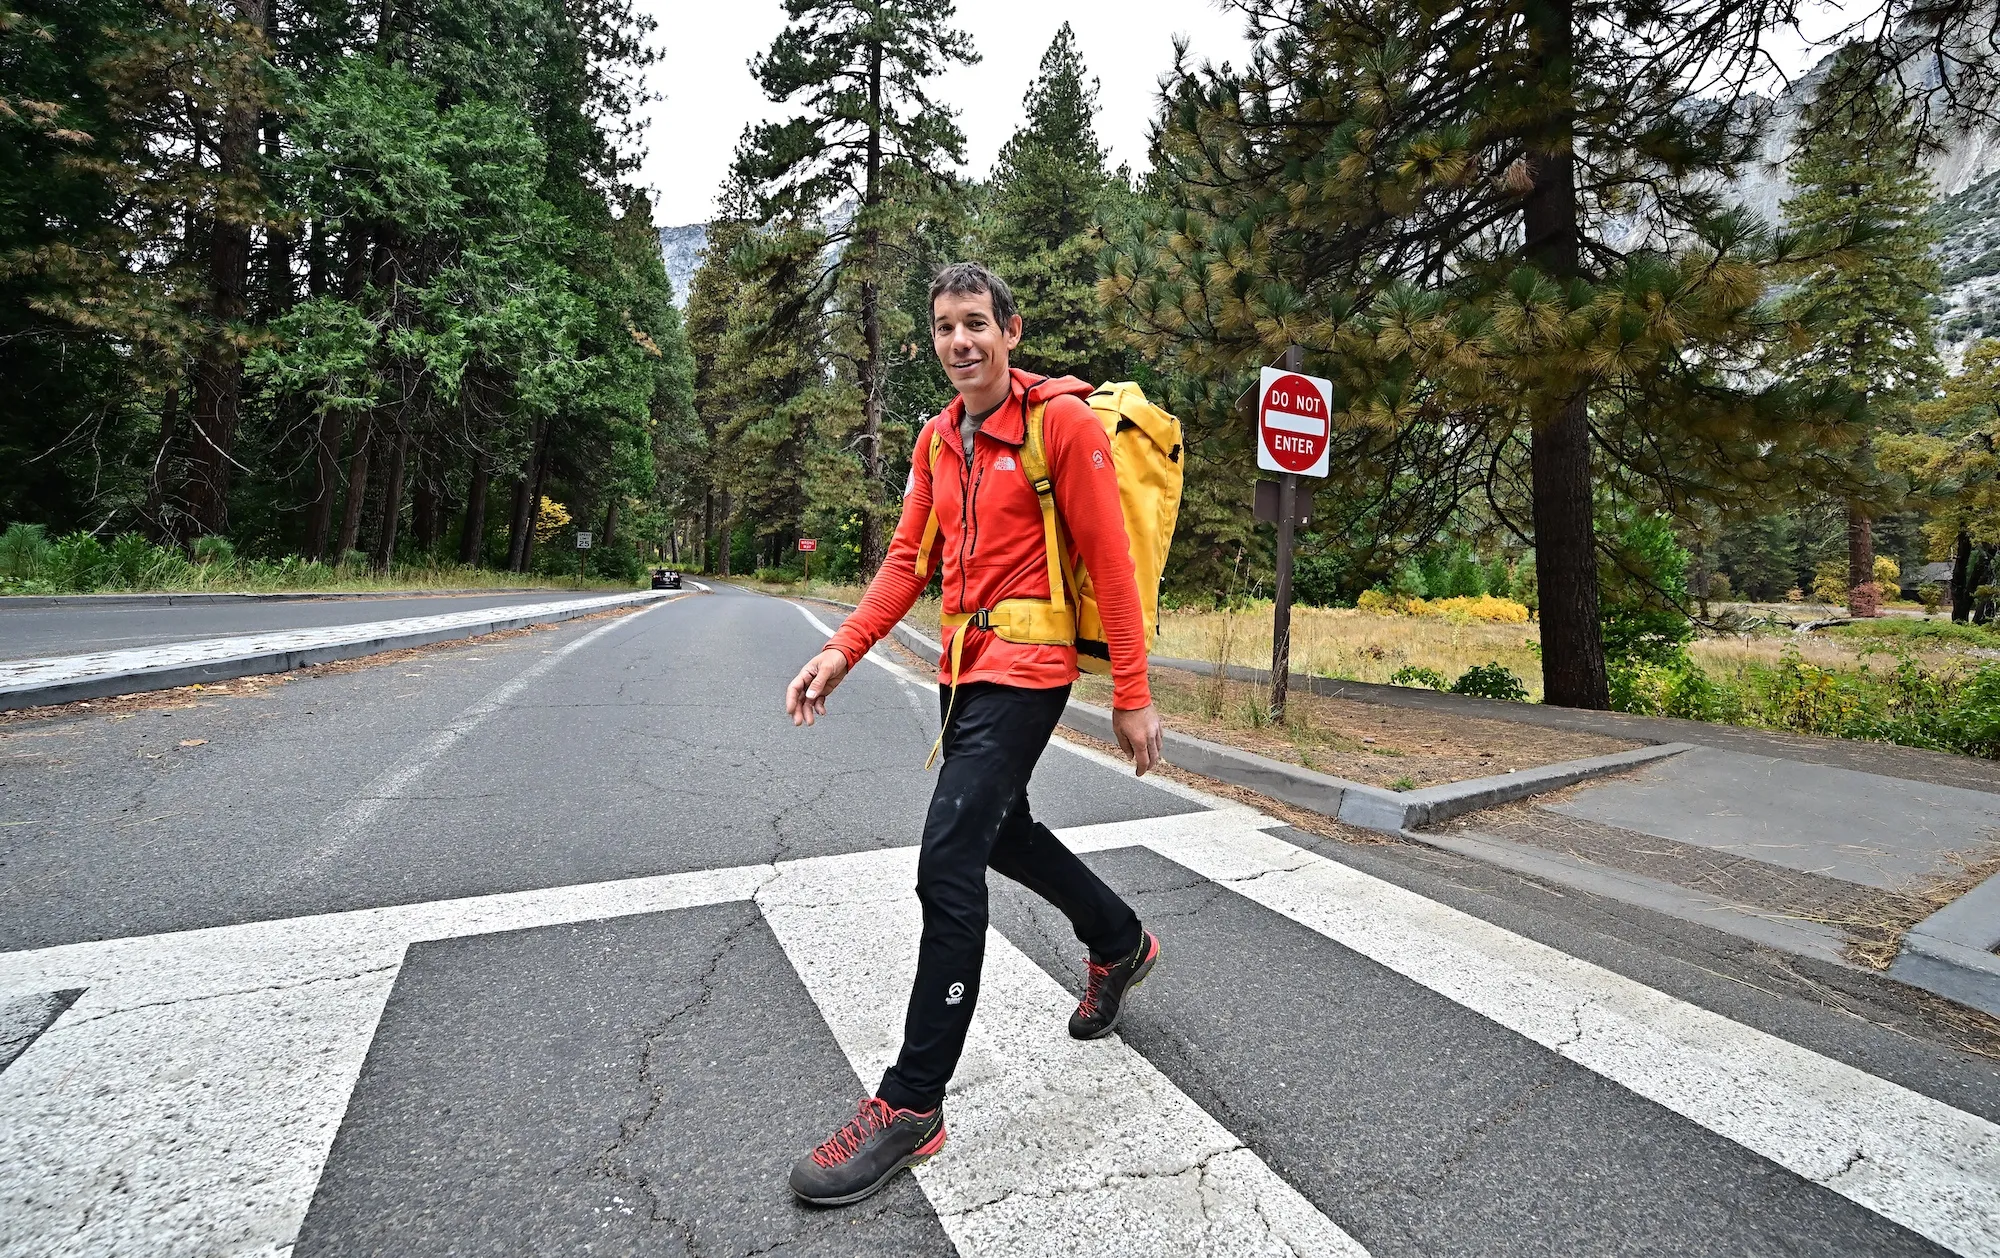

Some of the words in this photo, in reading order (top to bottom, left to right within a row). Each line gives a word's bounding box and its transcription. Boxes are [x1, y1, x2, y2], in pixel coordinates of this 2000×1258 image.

[1271, 389, 1289, 408] DO
[1296, 394, 1321, 413] NOT
[1274, 434, 1314, 455] ENTER
